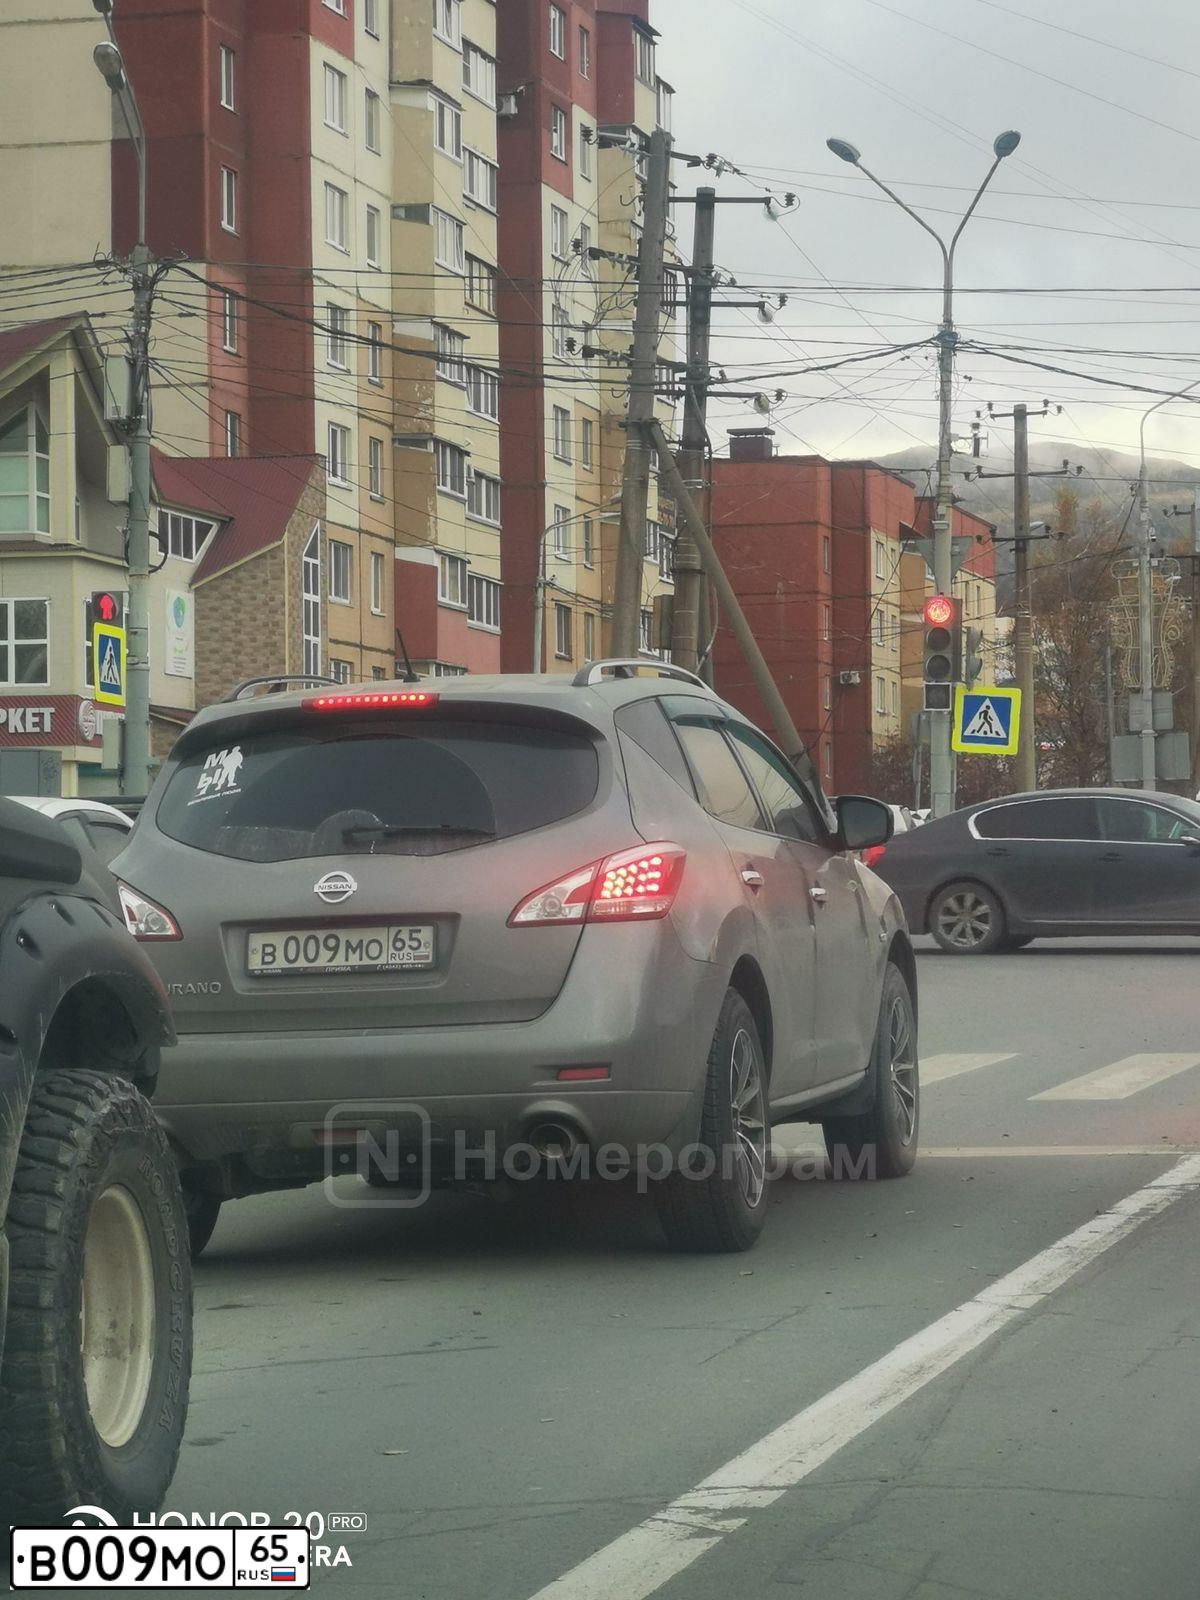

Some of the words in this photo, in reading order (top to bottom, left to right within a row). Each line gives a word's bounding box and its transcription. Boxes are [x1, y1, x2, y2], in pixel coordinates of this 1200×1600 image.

[319, 882, 352, 891] NISSAN
[391, 929, 423, 951] 65
[390, 952, 413, 962] RUS
